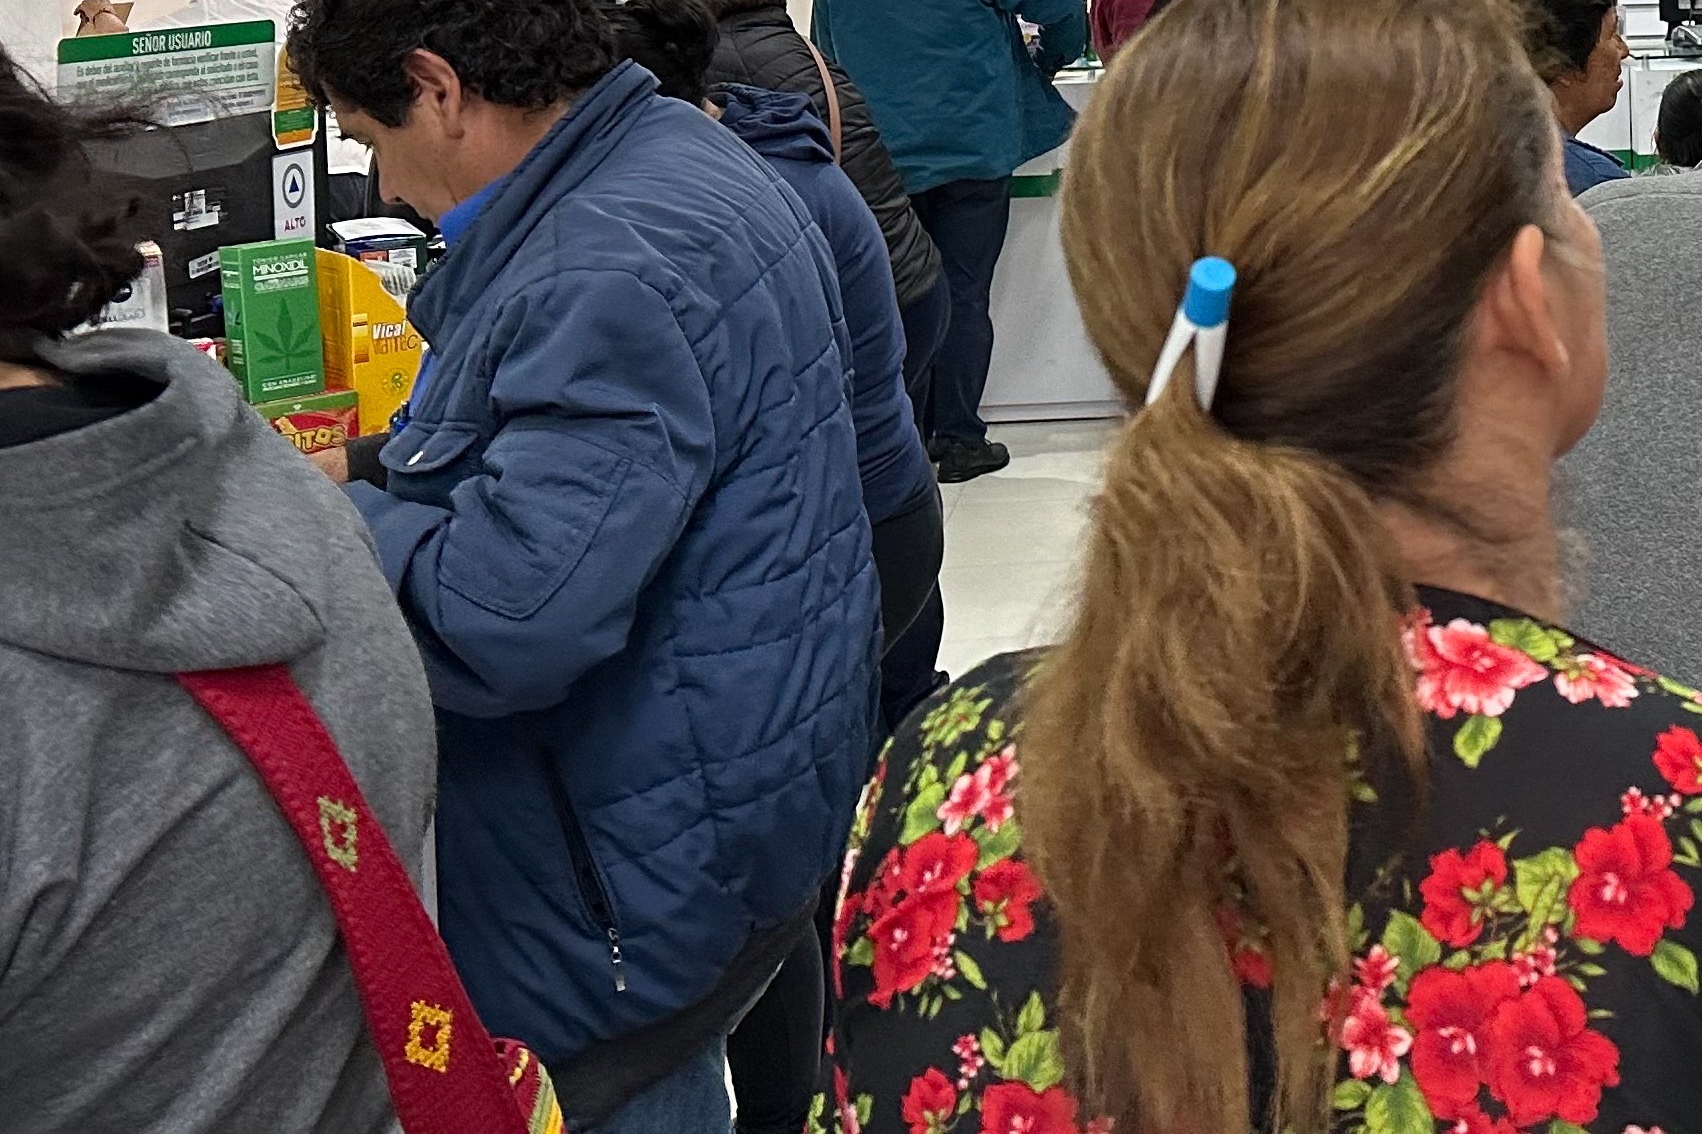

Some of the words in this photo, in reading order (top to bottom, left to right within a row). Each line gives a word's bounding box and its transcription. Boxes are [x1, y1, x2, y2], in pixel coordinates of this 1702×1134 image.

[132, 33, 166, 55] SEÑOR
[168, 30, 212, 50] USUARIO
[284, 216, 306, 232] ALTO
[253, 259, 308, 276] MINOXIDIL
[373, 319, 406, 340] Vical
[292, 425, 346, 449] ITOS
